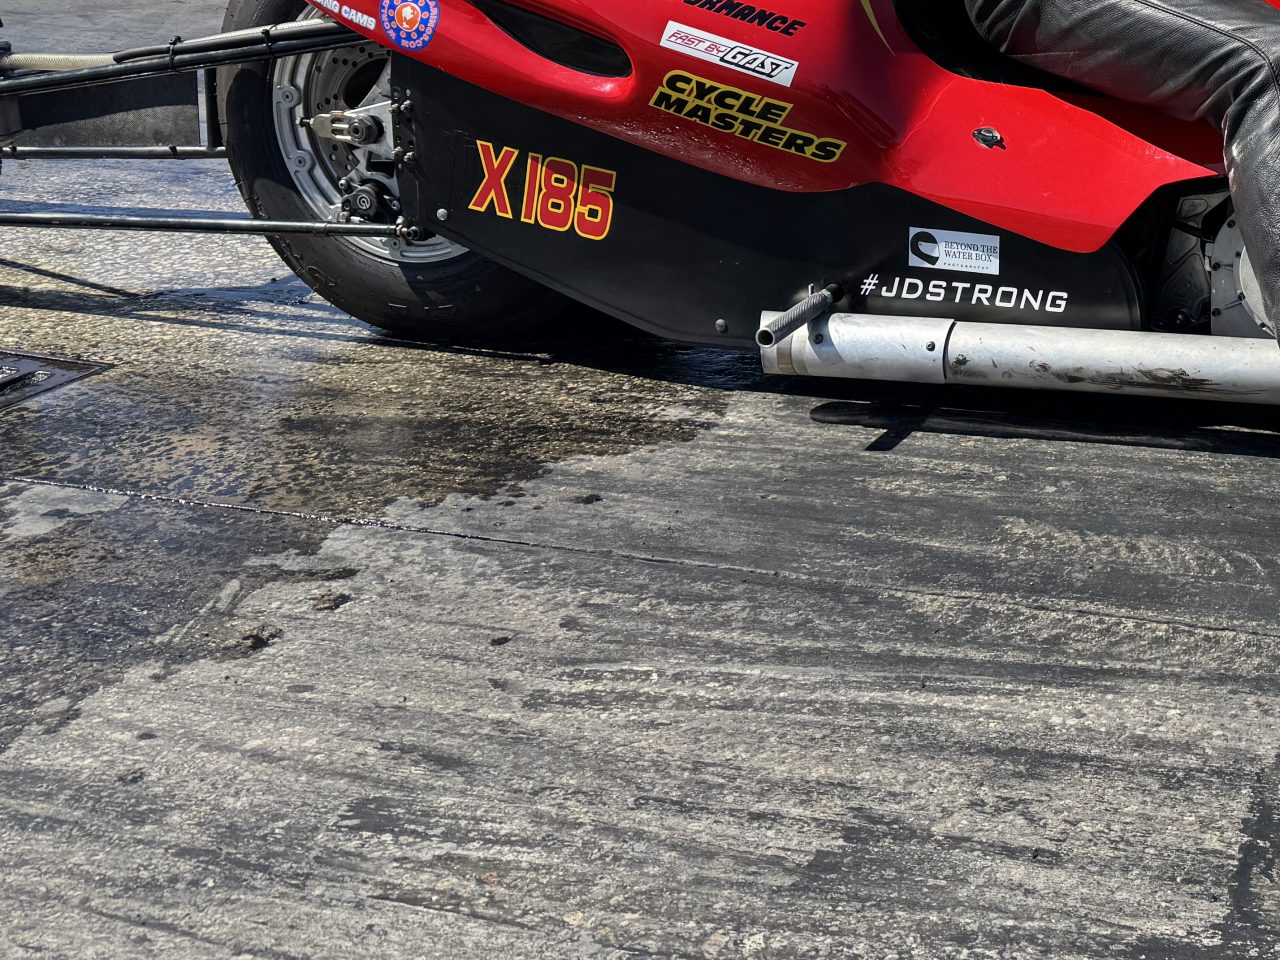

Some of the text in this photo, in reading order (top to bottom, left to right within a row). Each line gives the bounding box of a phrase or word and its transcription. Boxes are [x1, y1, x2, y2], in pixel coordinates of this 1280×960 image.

[341, 8, 376, 32] CAMS
[668, 30, 792, 77] FAST BY GAST
[663, 71, 792, 123] CYCLE
[650, 92, 846, 162] MASTERS
[943, 249, 993, 263] WATER BOX
[944, 240, 998, 255] BEYOND THE
[860, 273, 1069, 313] #JDSTRONG
